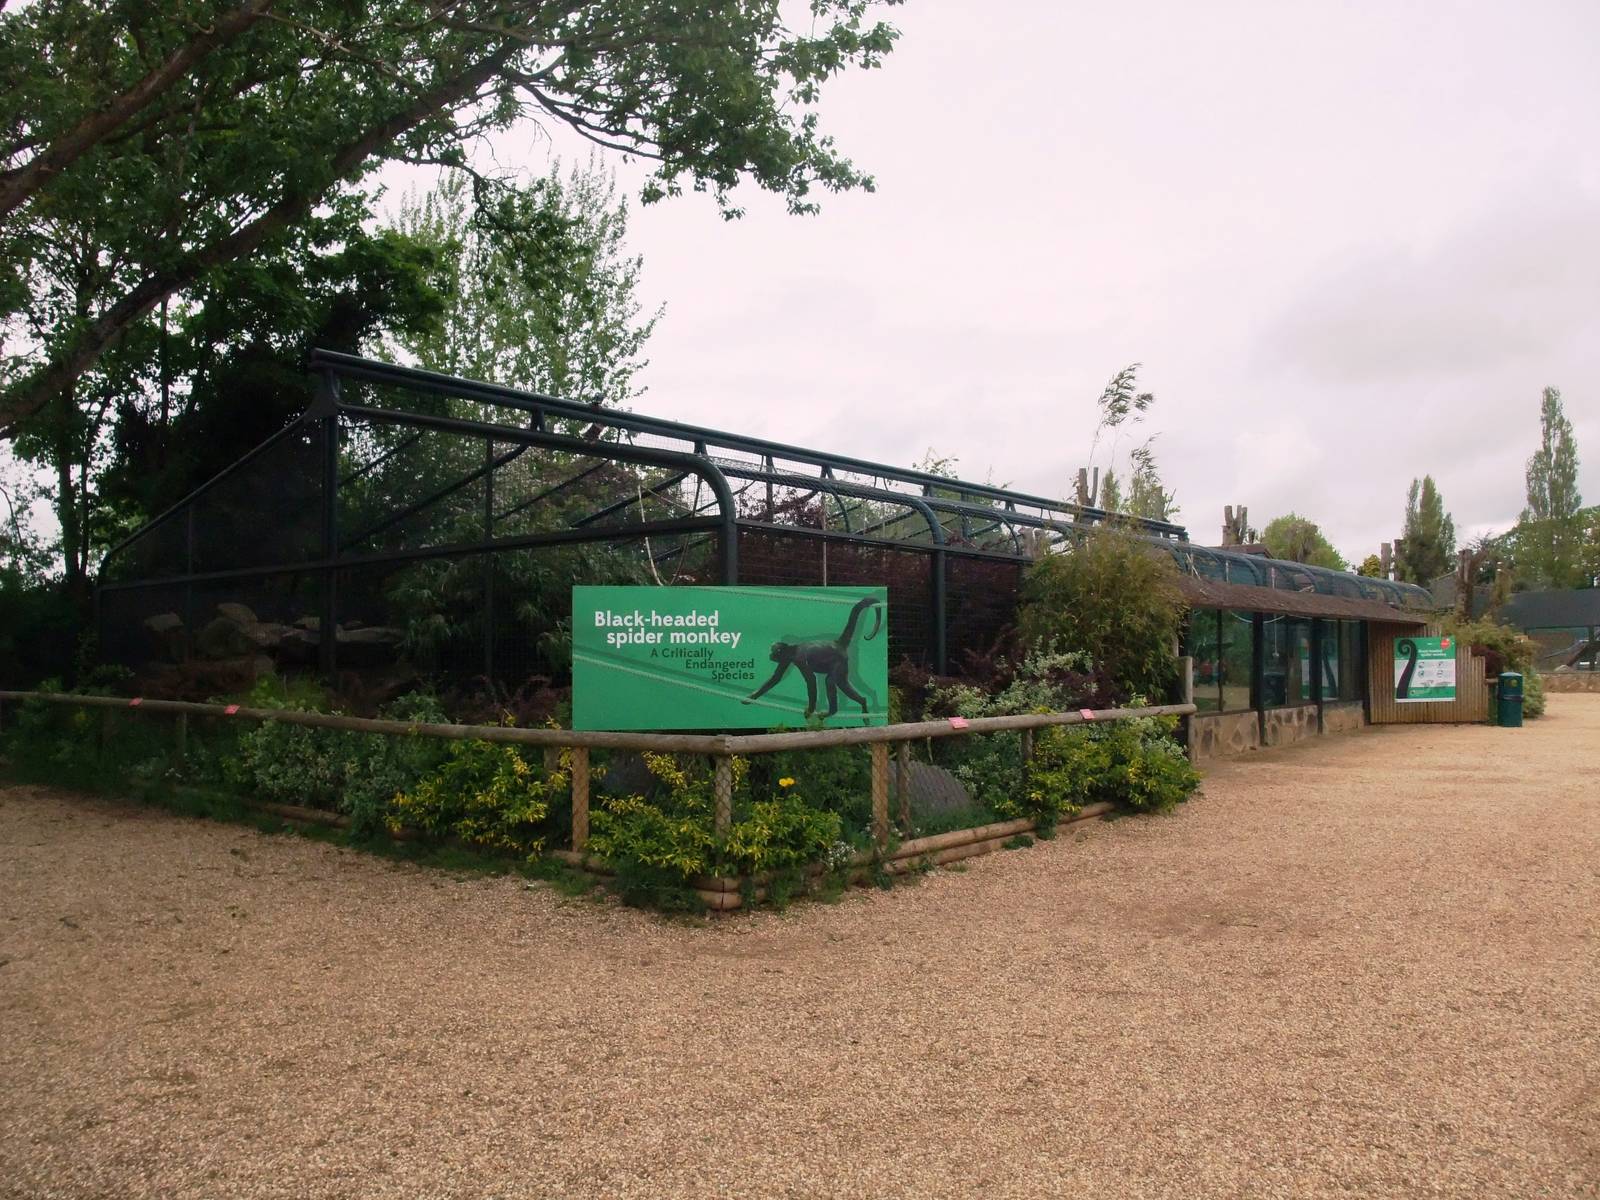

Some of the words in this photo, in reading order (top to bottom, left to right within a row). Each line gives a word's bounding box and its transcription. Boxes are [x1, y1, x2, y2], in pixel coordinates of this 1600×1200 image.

[594, 610, 719, 627] Black-headed
[607, 627, 663, 648] spider
[670, 627, 741, 648] monkey
[650, 648, 658, 658] A
[661, 648, 714, 660] Critically
[685, 658, 755, 672] Endangered
[711, 669, 755, 682] Species
